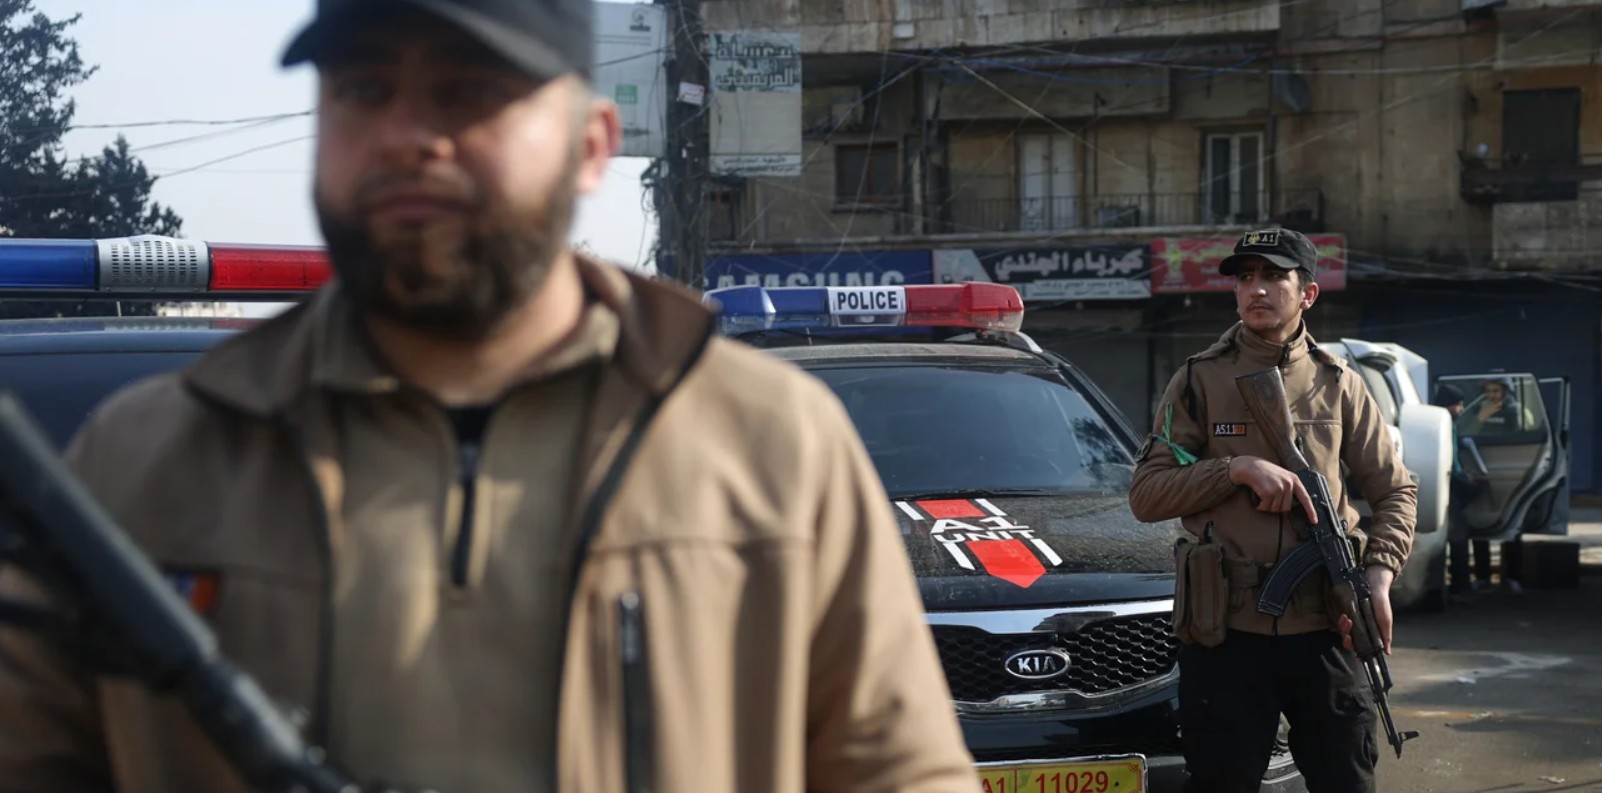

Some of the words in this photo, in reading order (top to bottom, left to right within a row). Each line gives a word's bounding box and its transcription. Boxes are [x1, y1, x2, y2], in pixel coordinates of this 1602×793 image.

[994, 250, 1070, 282] الجندي
[1071, 247, 1145, 277] كهرباء
[703, 270, 905, 287] AMSUNG
[837, 290, 898, 310] POLICE
[930, 516, 1030, 534] A1
[933, 530, 1035, 543] UNIT
[1017, 656, 1057, 673] KIA
[982, 777, 1006, 793] A1
[1035, 770, 1109, 793] 11029
